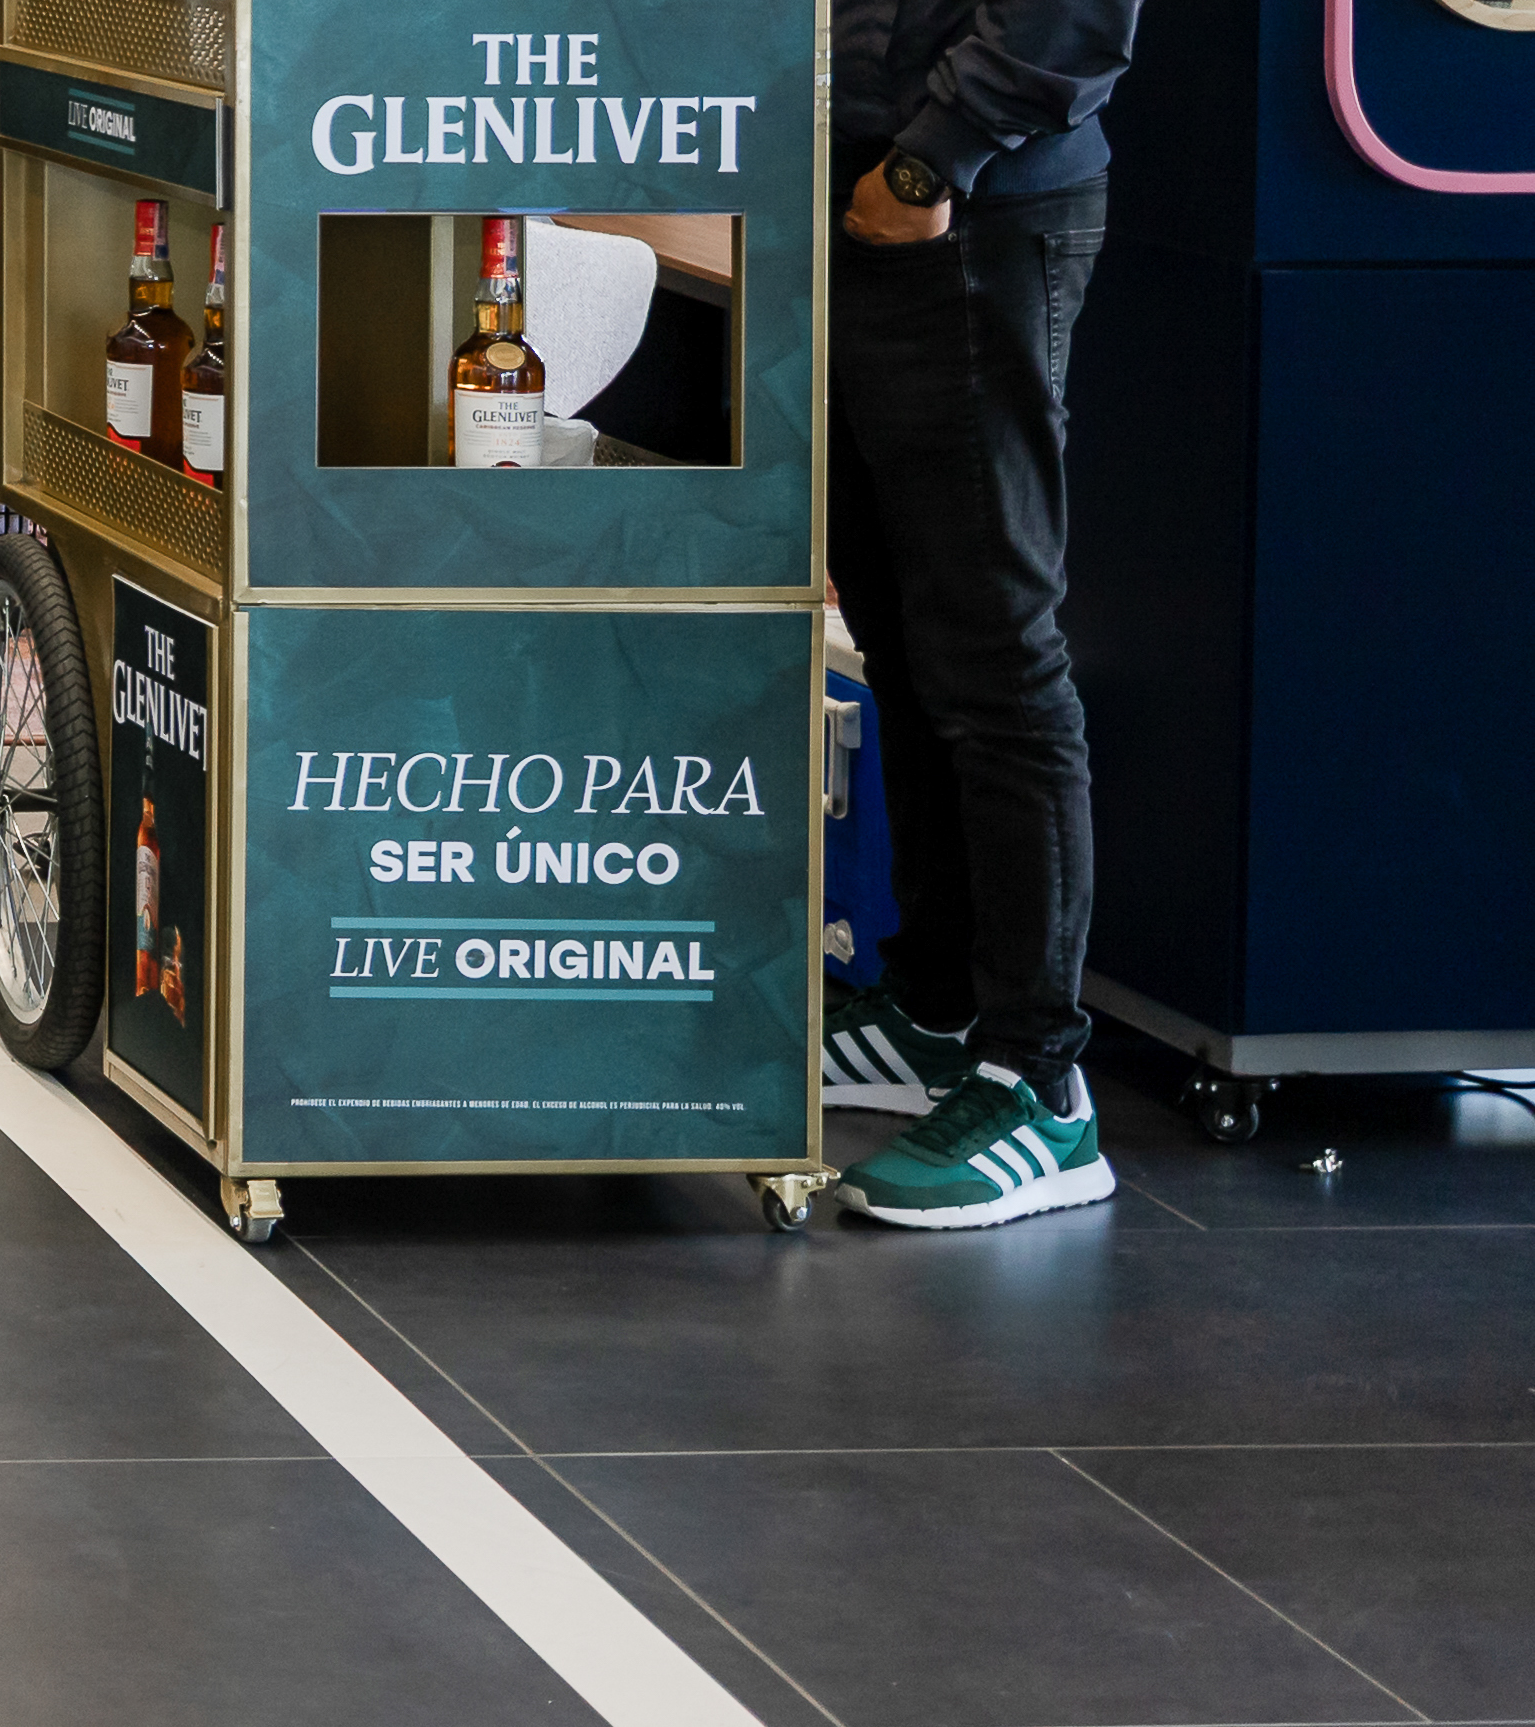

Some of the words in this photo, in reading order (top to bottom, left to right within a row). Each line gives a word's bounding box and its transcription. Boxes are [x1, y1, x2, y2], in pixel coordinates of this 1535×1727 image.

[471, 32, 600, 87] THE
[67, 100, 88, 129] LIVE
[89, 106, 137, 143] ORIGINAL
[311, 94, 757, 175] GLENLIVET
[472, 409, 538, 424] GLENLIVET
[497, 401, 519, 411] THE
[143, 624, 176, 682] THE
[112, 659, 208, 772] GLENLIVET
[287, 750, 564, 815] HECHO
[573, 753, 766, 817] PARA
[370, 840, 475, 885] SER
[494, 827, 680, 887] ÚNICO
[329, 937, 443, 981] LIVE
[455, 938, 716, 982] ORIGINAL
